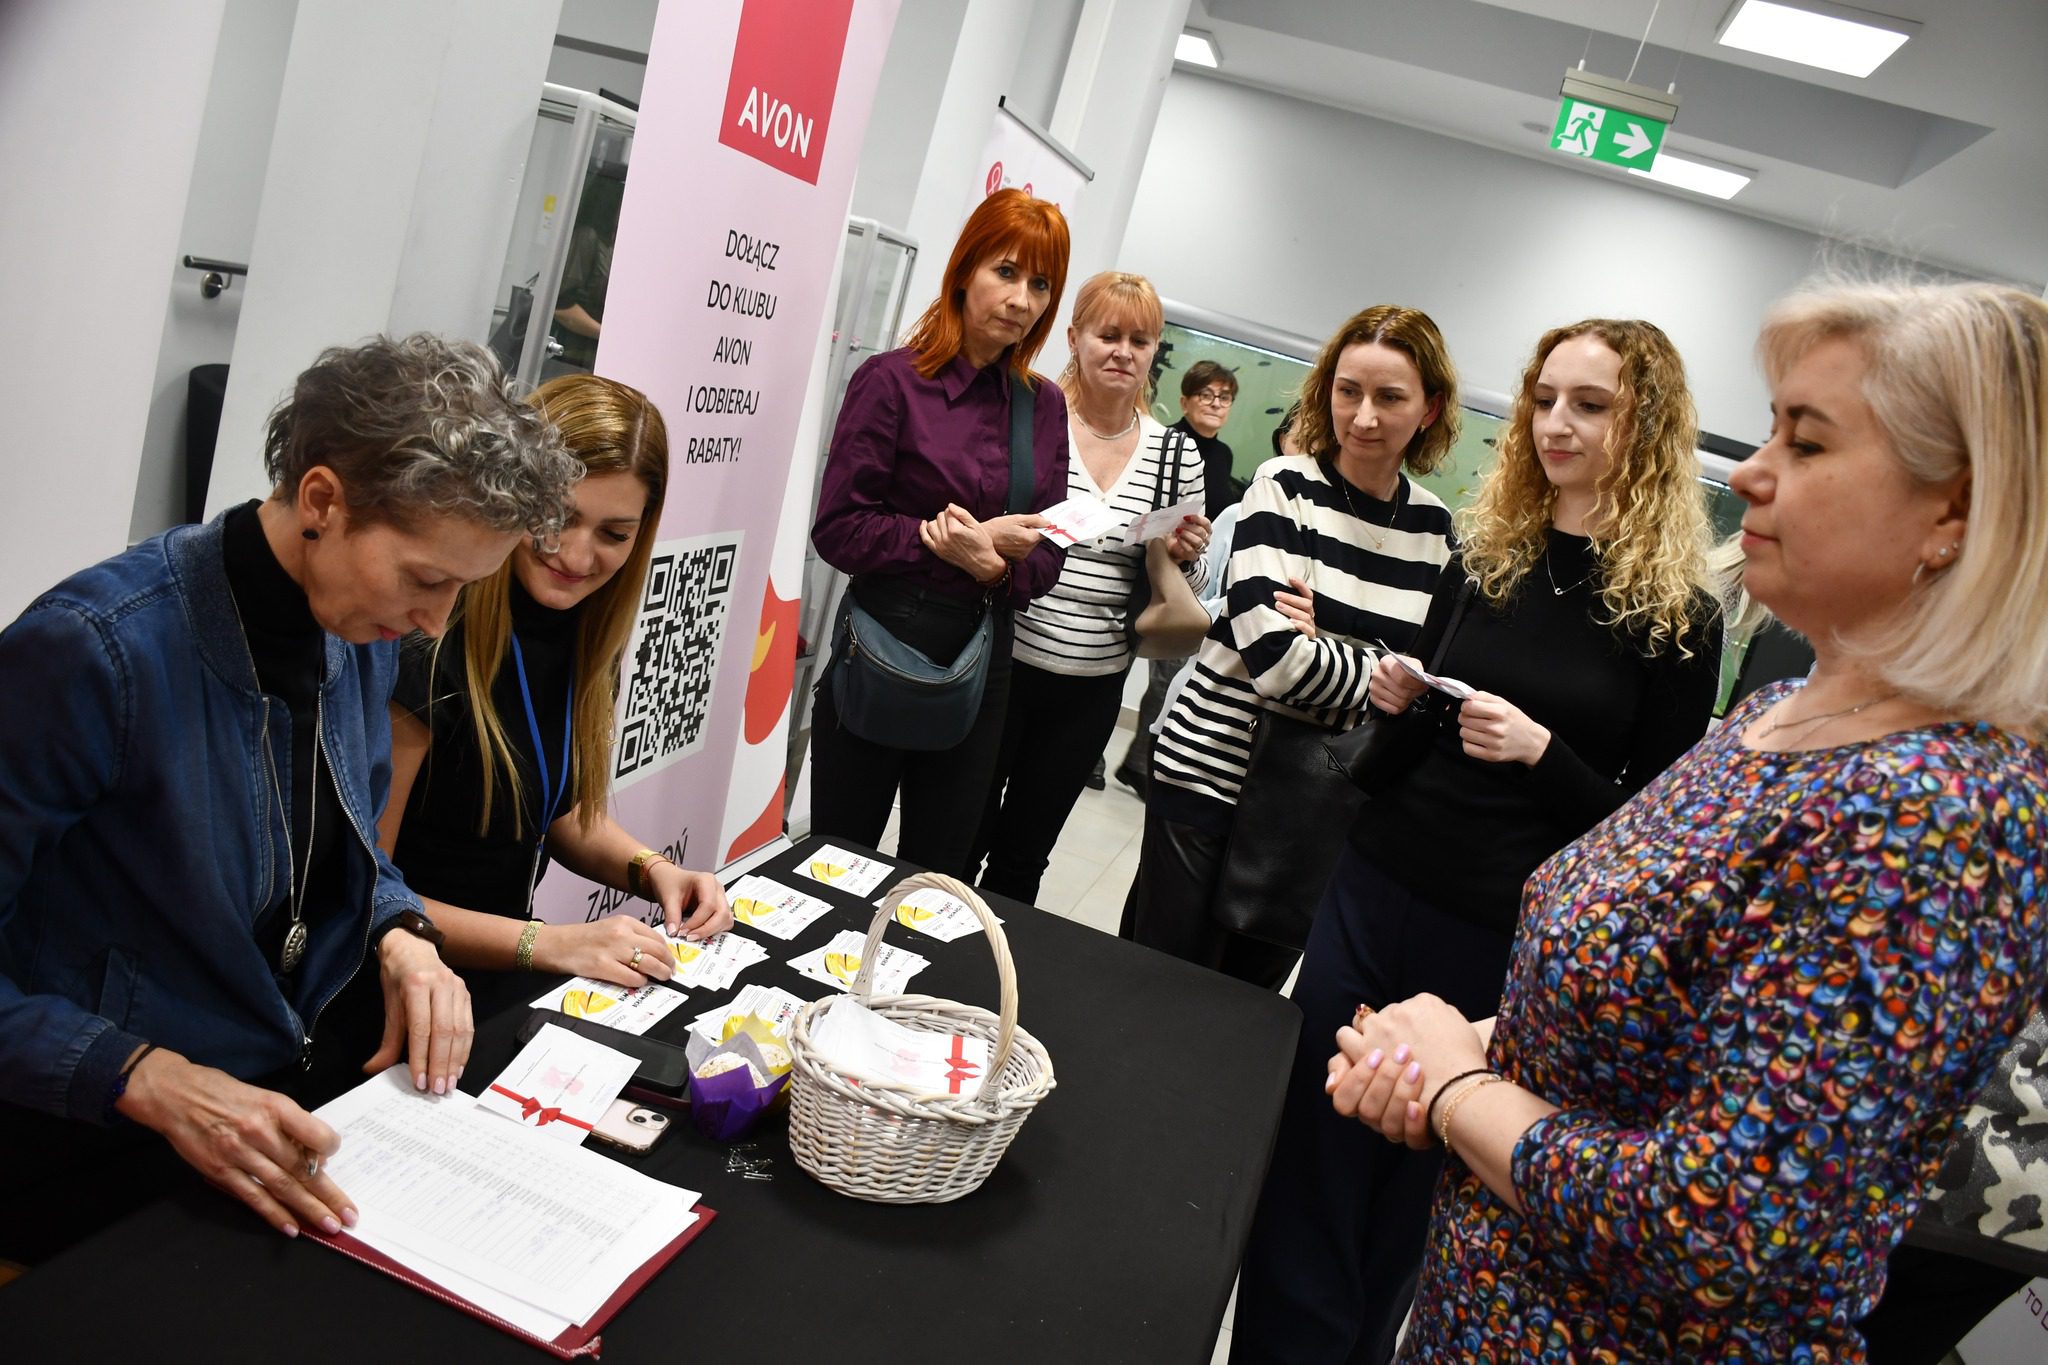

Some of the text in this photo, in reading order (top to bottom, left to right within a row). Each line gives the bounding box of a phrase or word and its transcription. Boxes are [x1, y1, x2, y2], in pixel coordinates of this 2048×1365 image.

[737, 86, 814, 158] AVON
[725, 229, 780, 272] DOŁĄCZ
[707, 279, 778, 320] DO KLUBU
[712, 336, 753, 366] AVON
[686, 385, 760, 415] I ODBIERAJ
[686, 437, 742, 464] RABATY!
